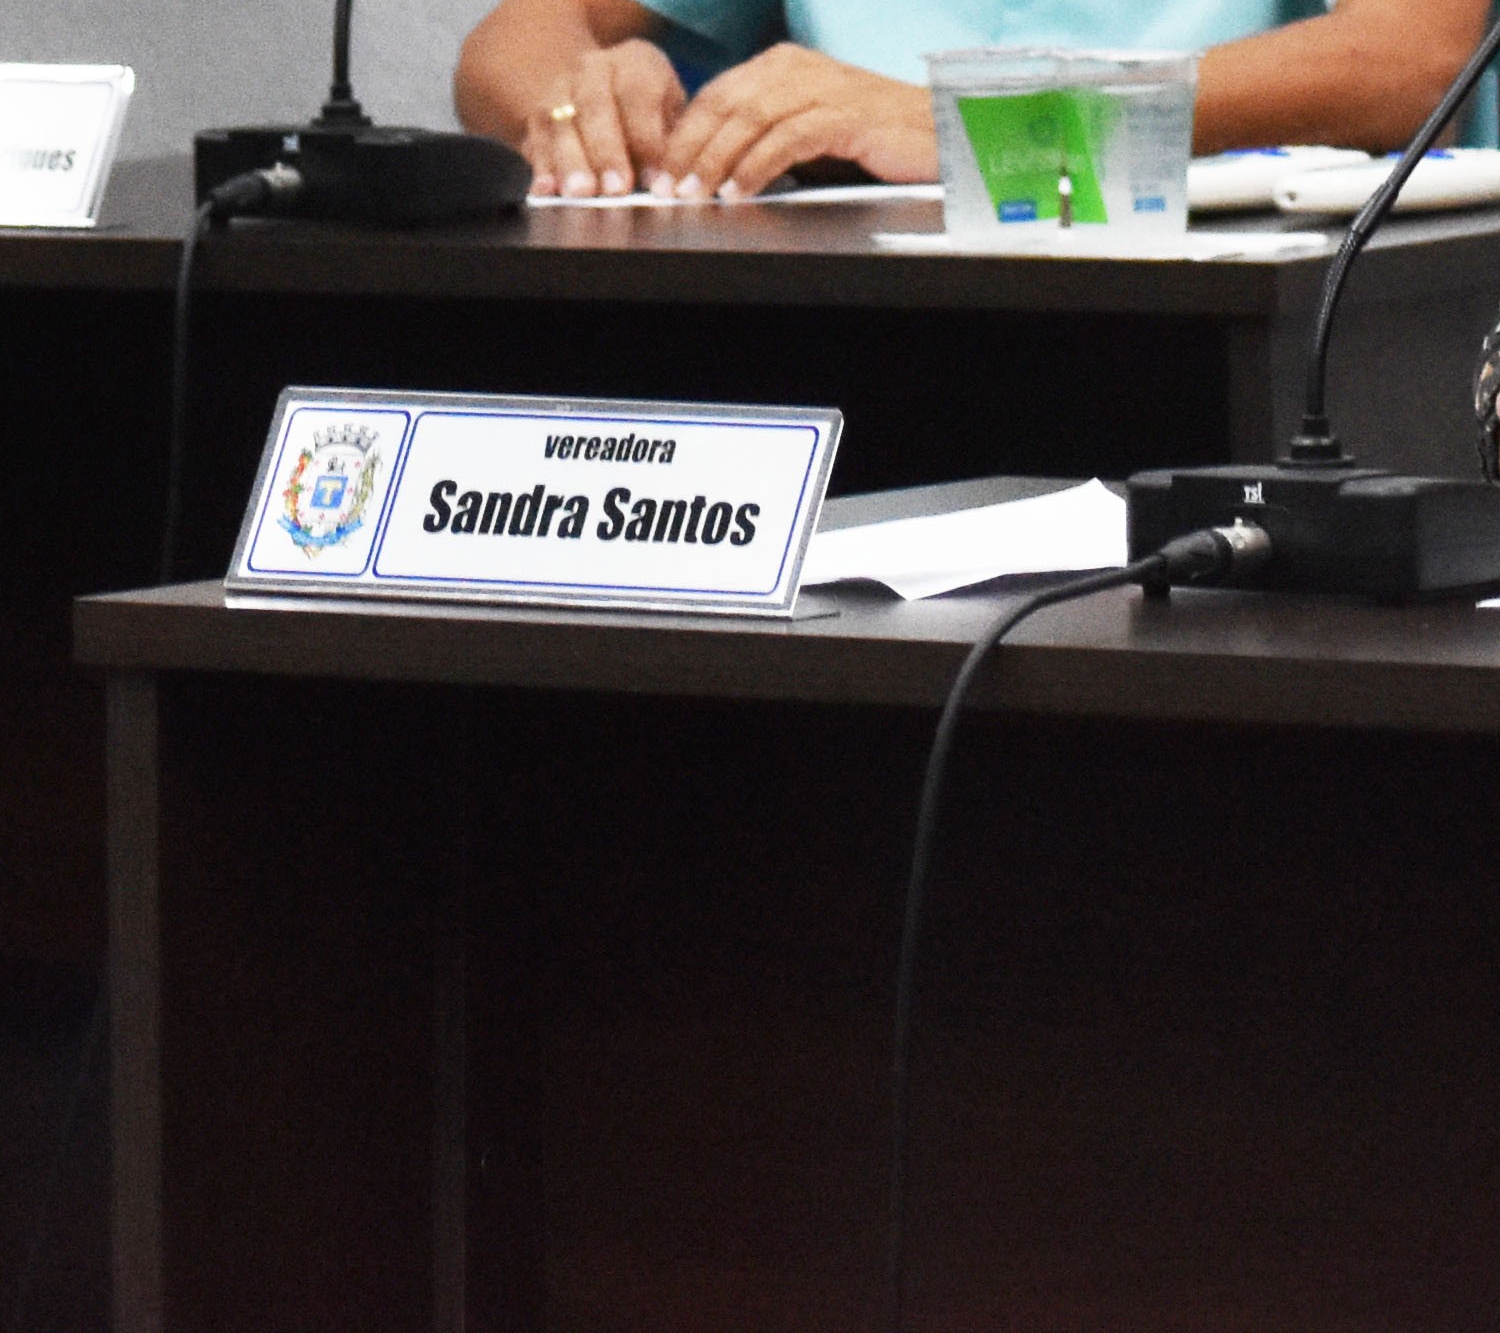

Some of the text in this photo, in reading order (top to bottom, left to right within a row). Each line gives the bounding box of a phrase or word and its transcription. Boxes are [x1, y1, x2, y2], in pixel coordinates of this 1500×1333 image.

[544, 433, 676, 463] vereadora
[422, 480, 761, 546] Sandra Santos
